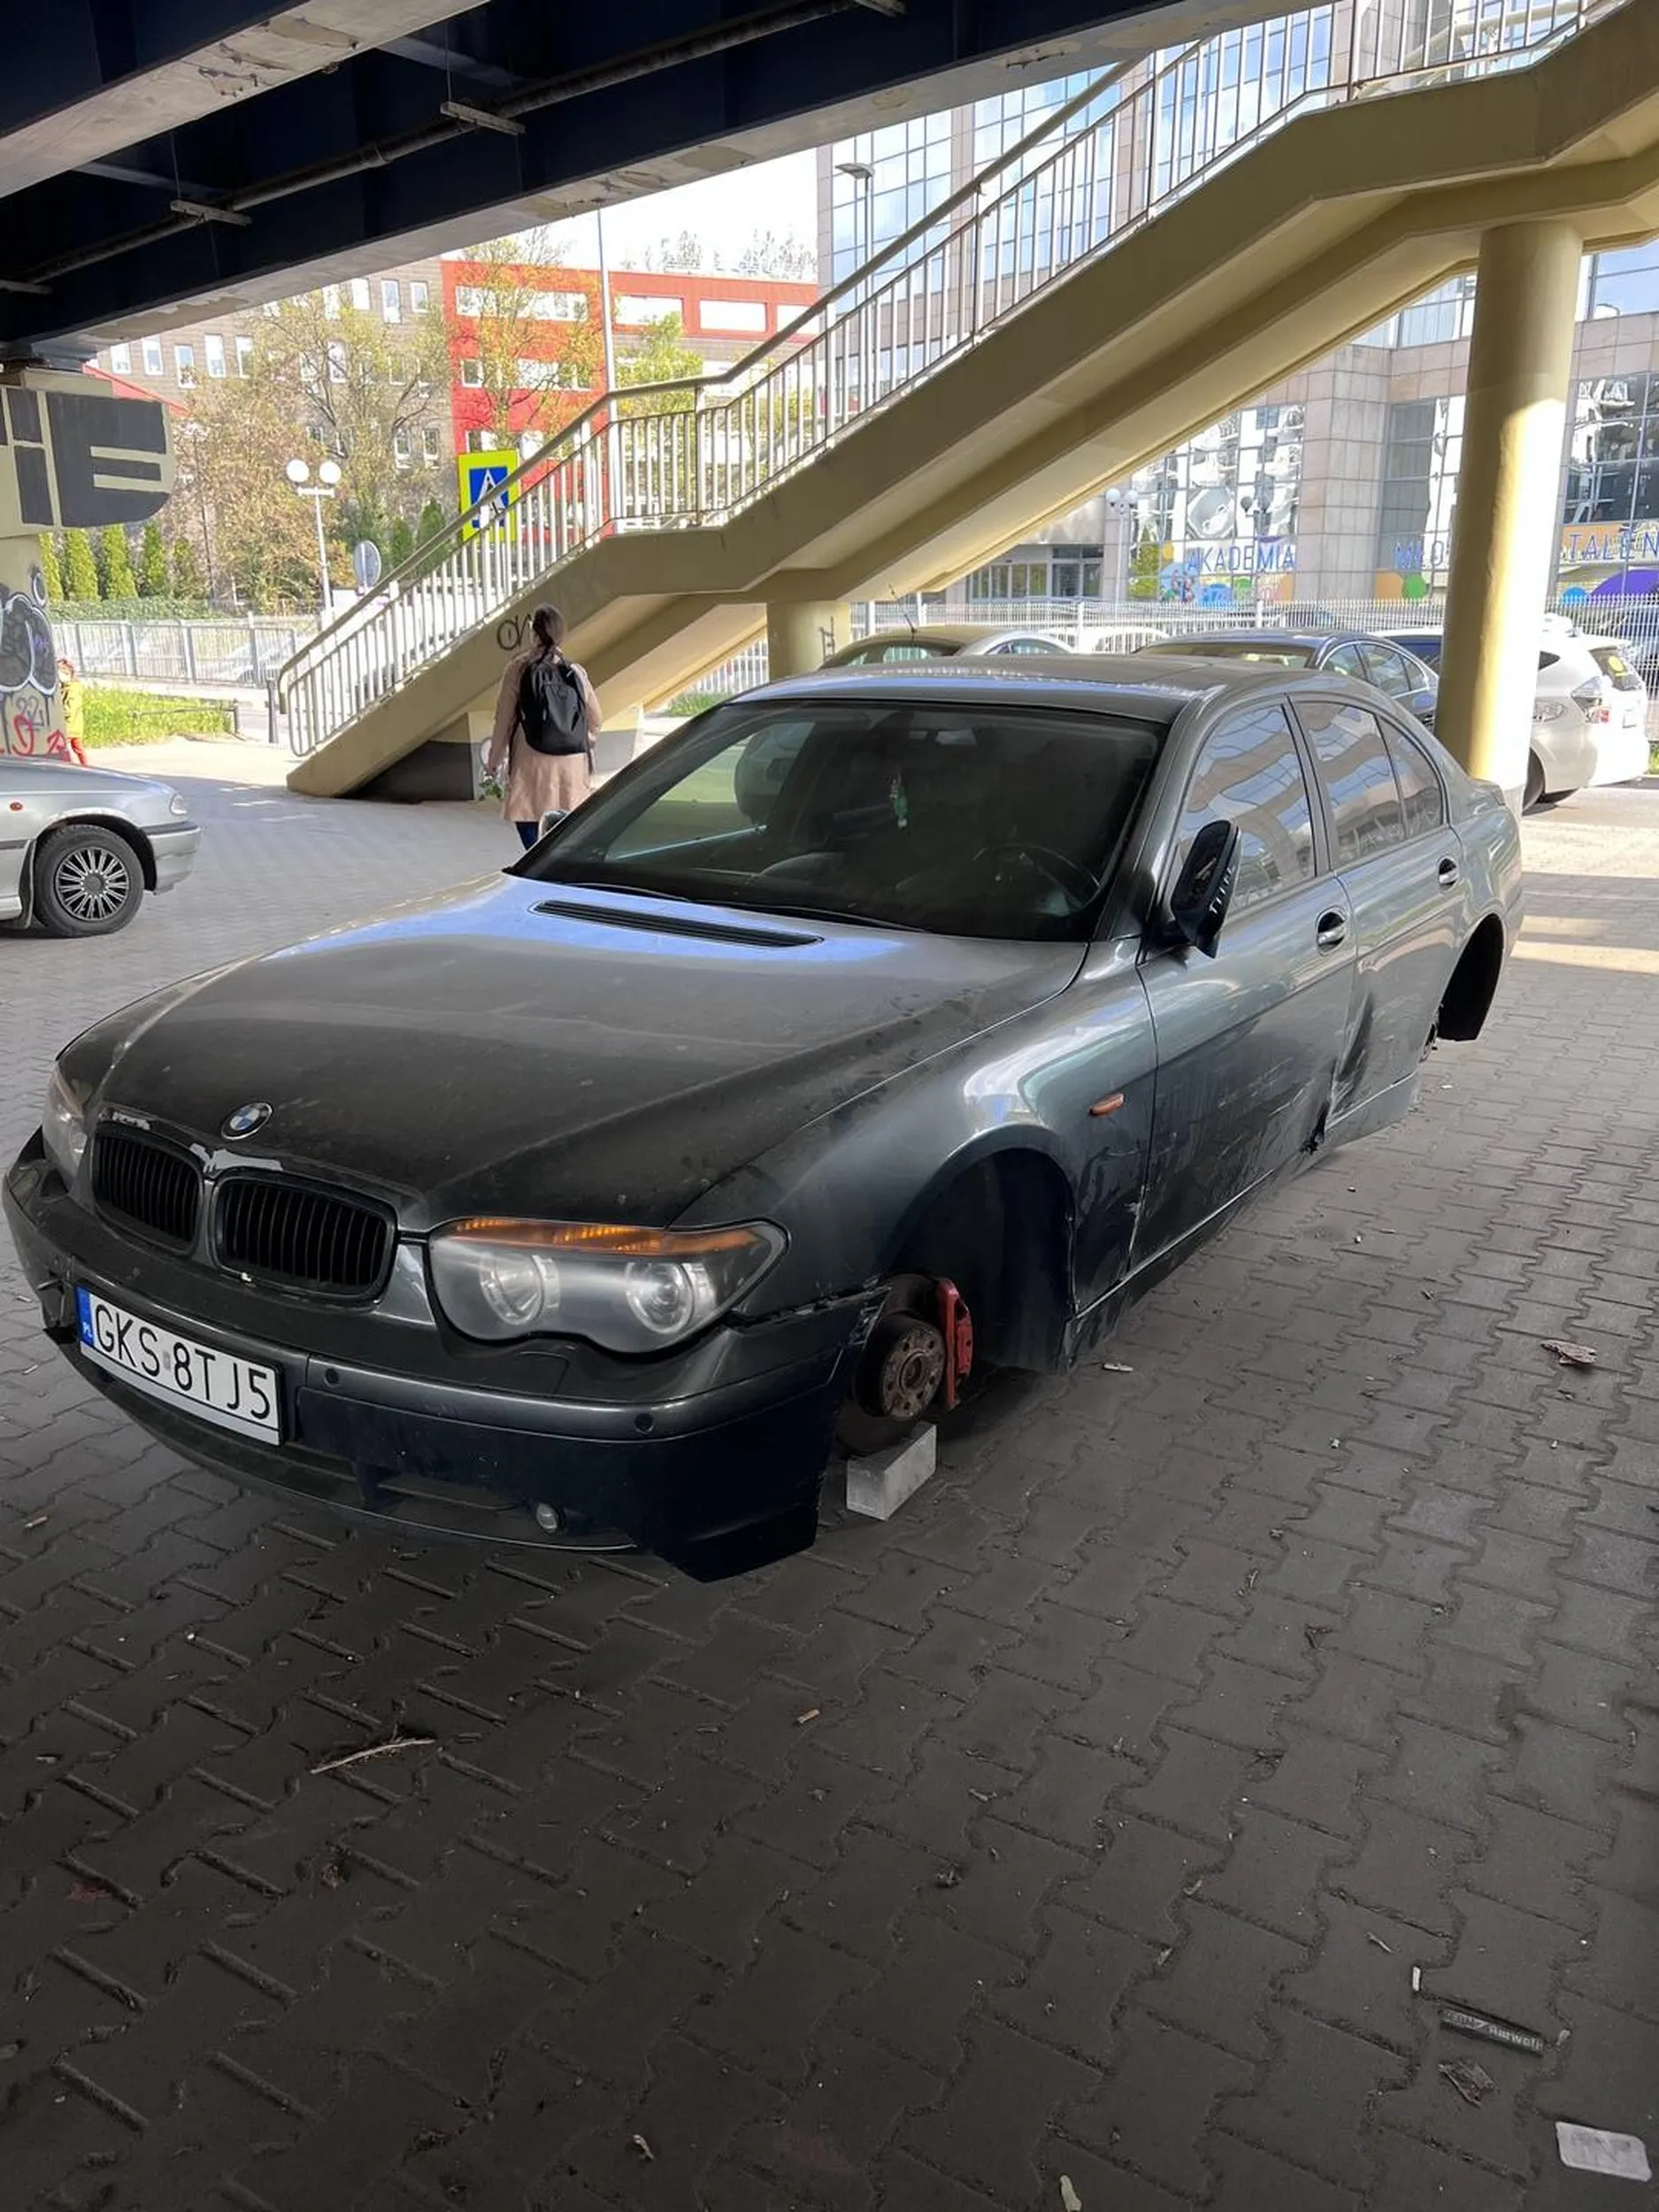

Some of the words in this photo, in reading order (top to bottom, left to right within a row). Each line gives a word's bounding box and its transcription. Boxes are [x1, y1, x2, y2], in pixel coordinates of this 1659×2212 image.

[1187, 544, 1295, 572] AKADEMIA
[96, 1303, 160, 1377] GKS
[173, 1341, 270, 1420] 8TJ5
